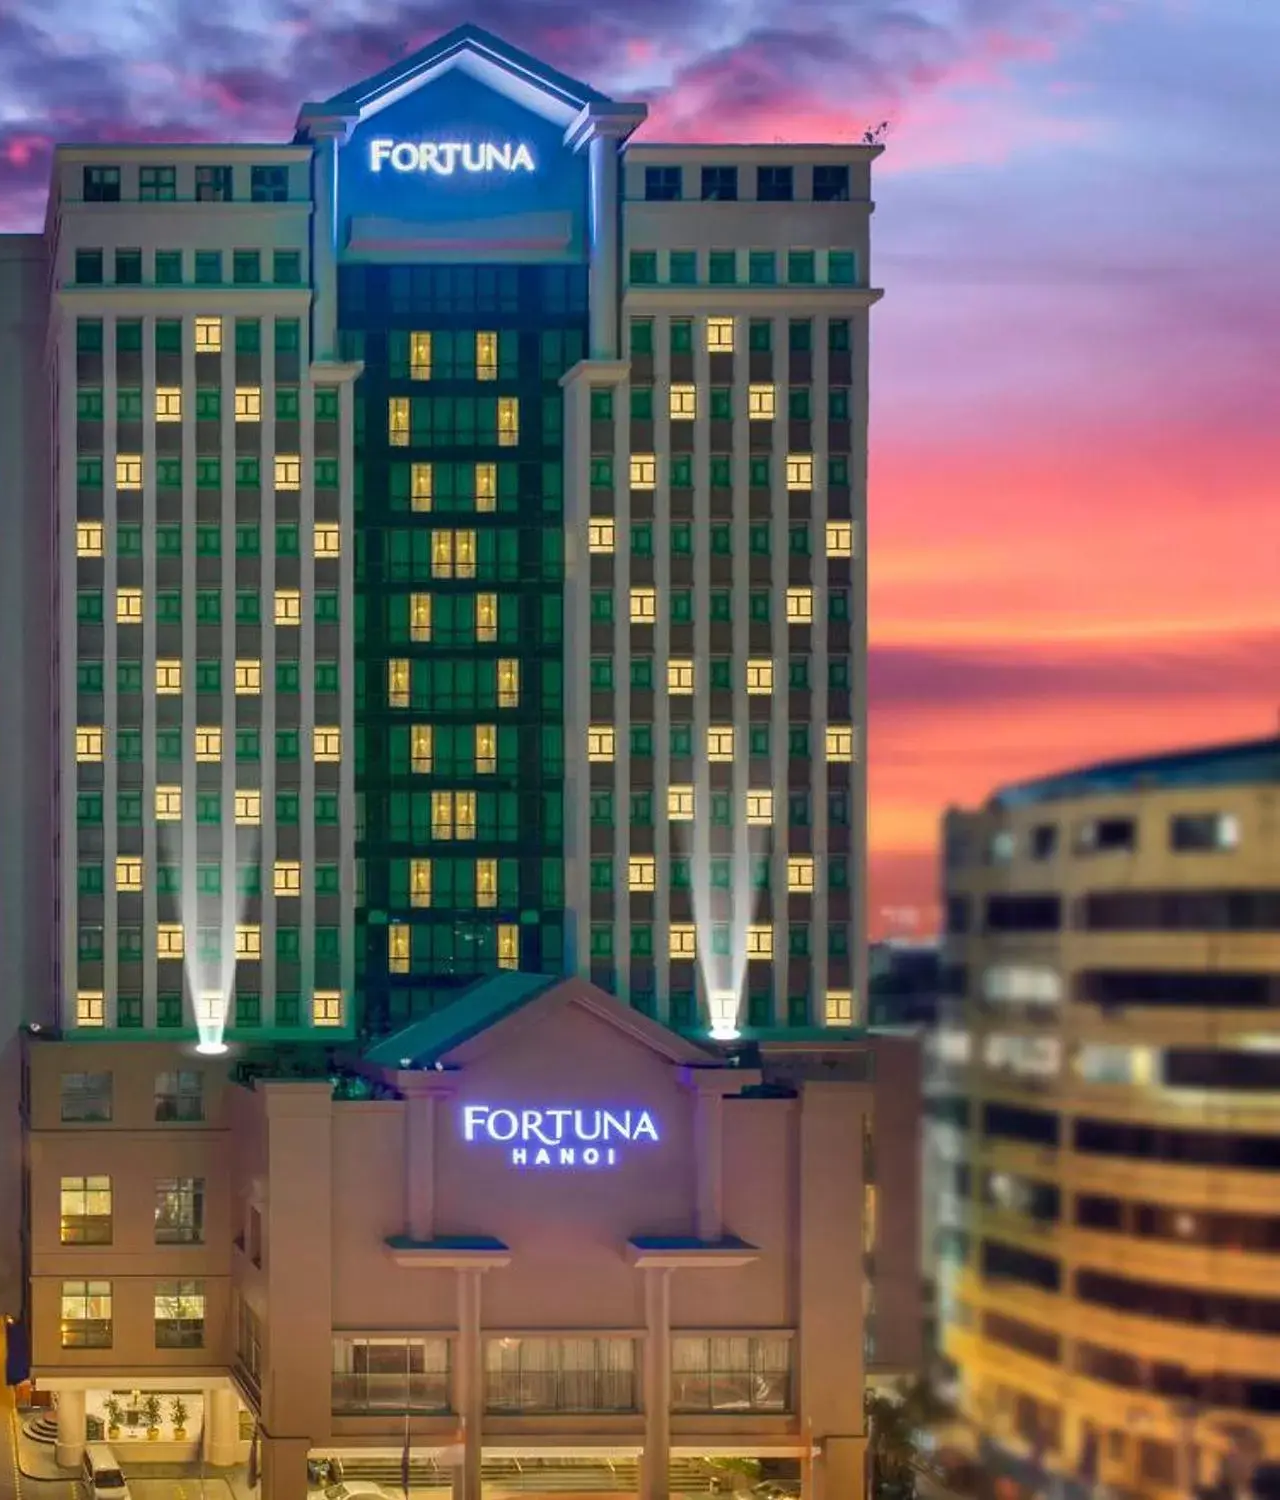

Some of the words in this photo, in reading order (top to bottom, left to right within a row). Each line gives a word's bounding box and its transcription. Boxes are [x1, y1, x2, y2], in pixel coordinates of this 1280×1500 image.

[370, 139, 536, 176] FORTUNA
[463, 1105, 660, 1146] FORTUNA
[512, 1147, 616, 1166] HANOI
